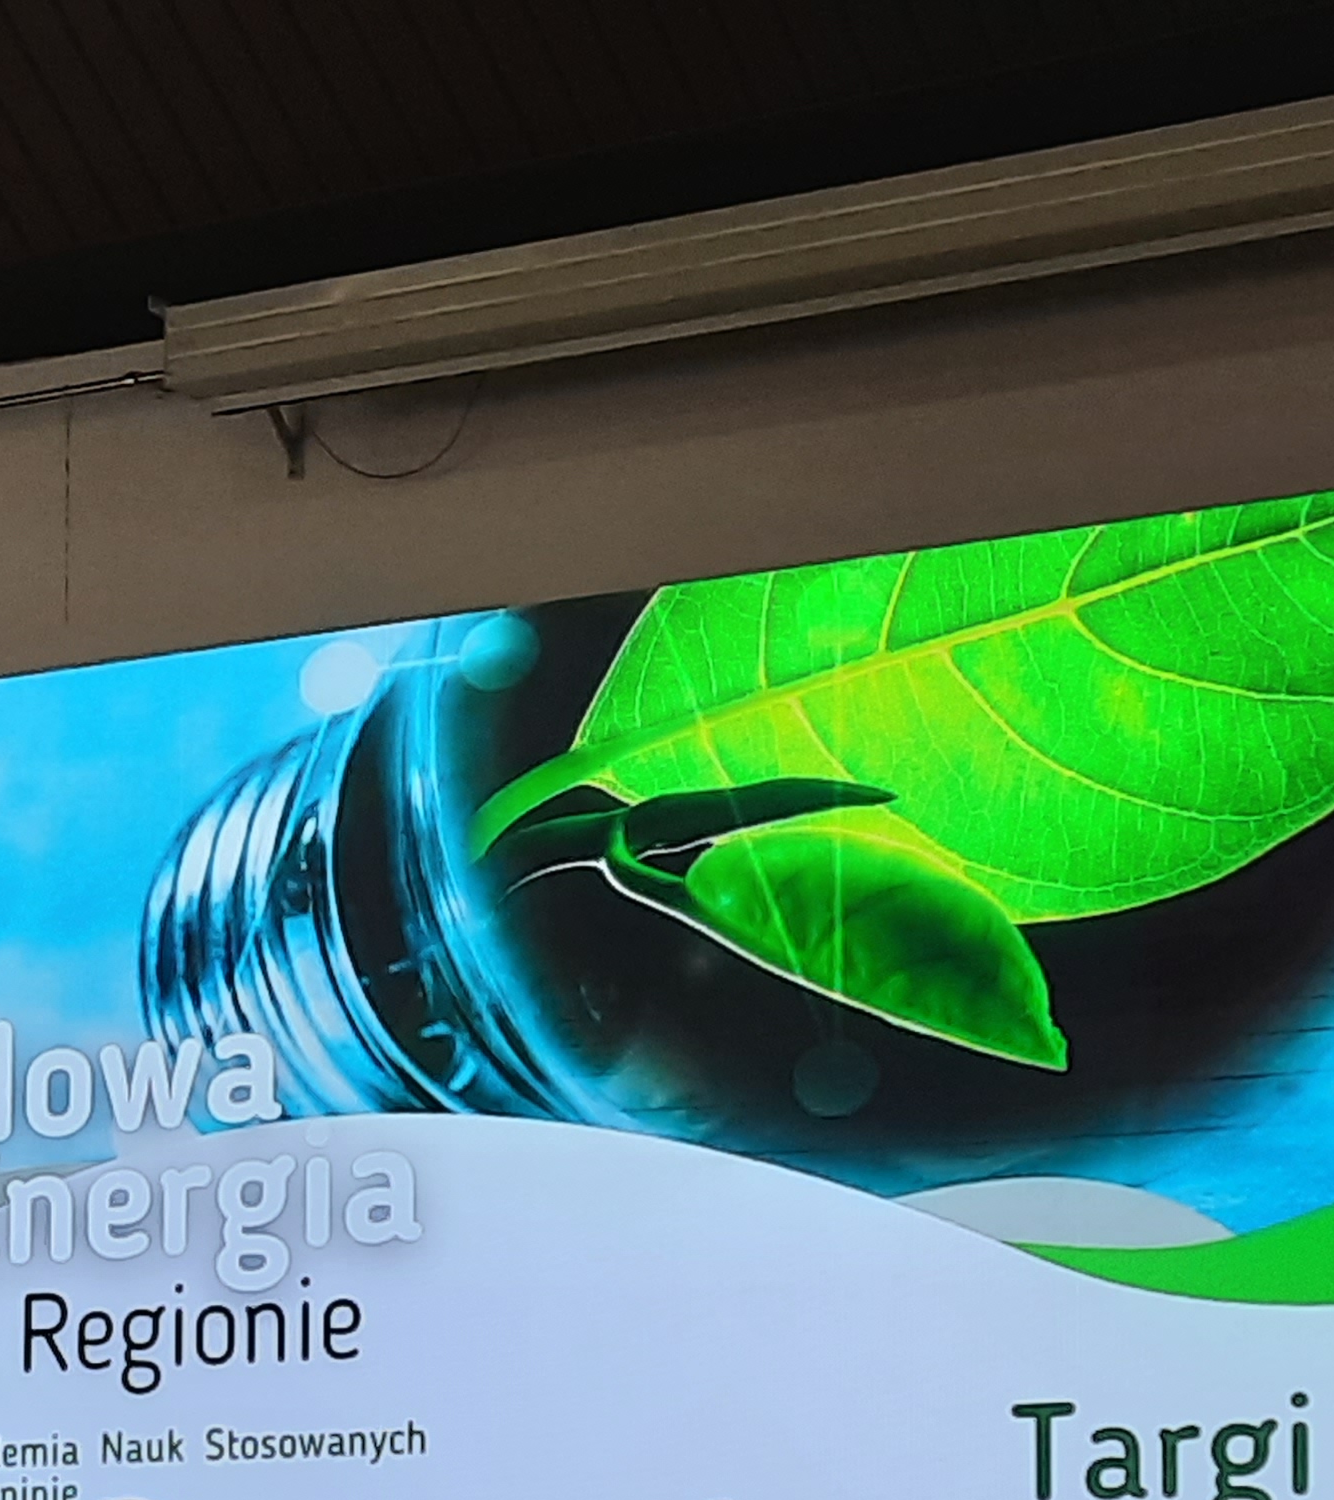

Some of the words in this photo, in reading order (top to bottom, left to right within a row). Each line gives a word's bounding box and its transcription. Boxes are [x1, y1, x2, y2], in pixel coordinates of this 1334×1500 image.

[22, 1276, 362, 1395] Regionie
[101, 1428, 184, 1464] Nauk
[205, 1421, 427, 1464] Stosowanych
